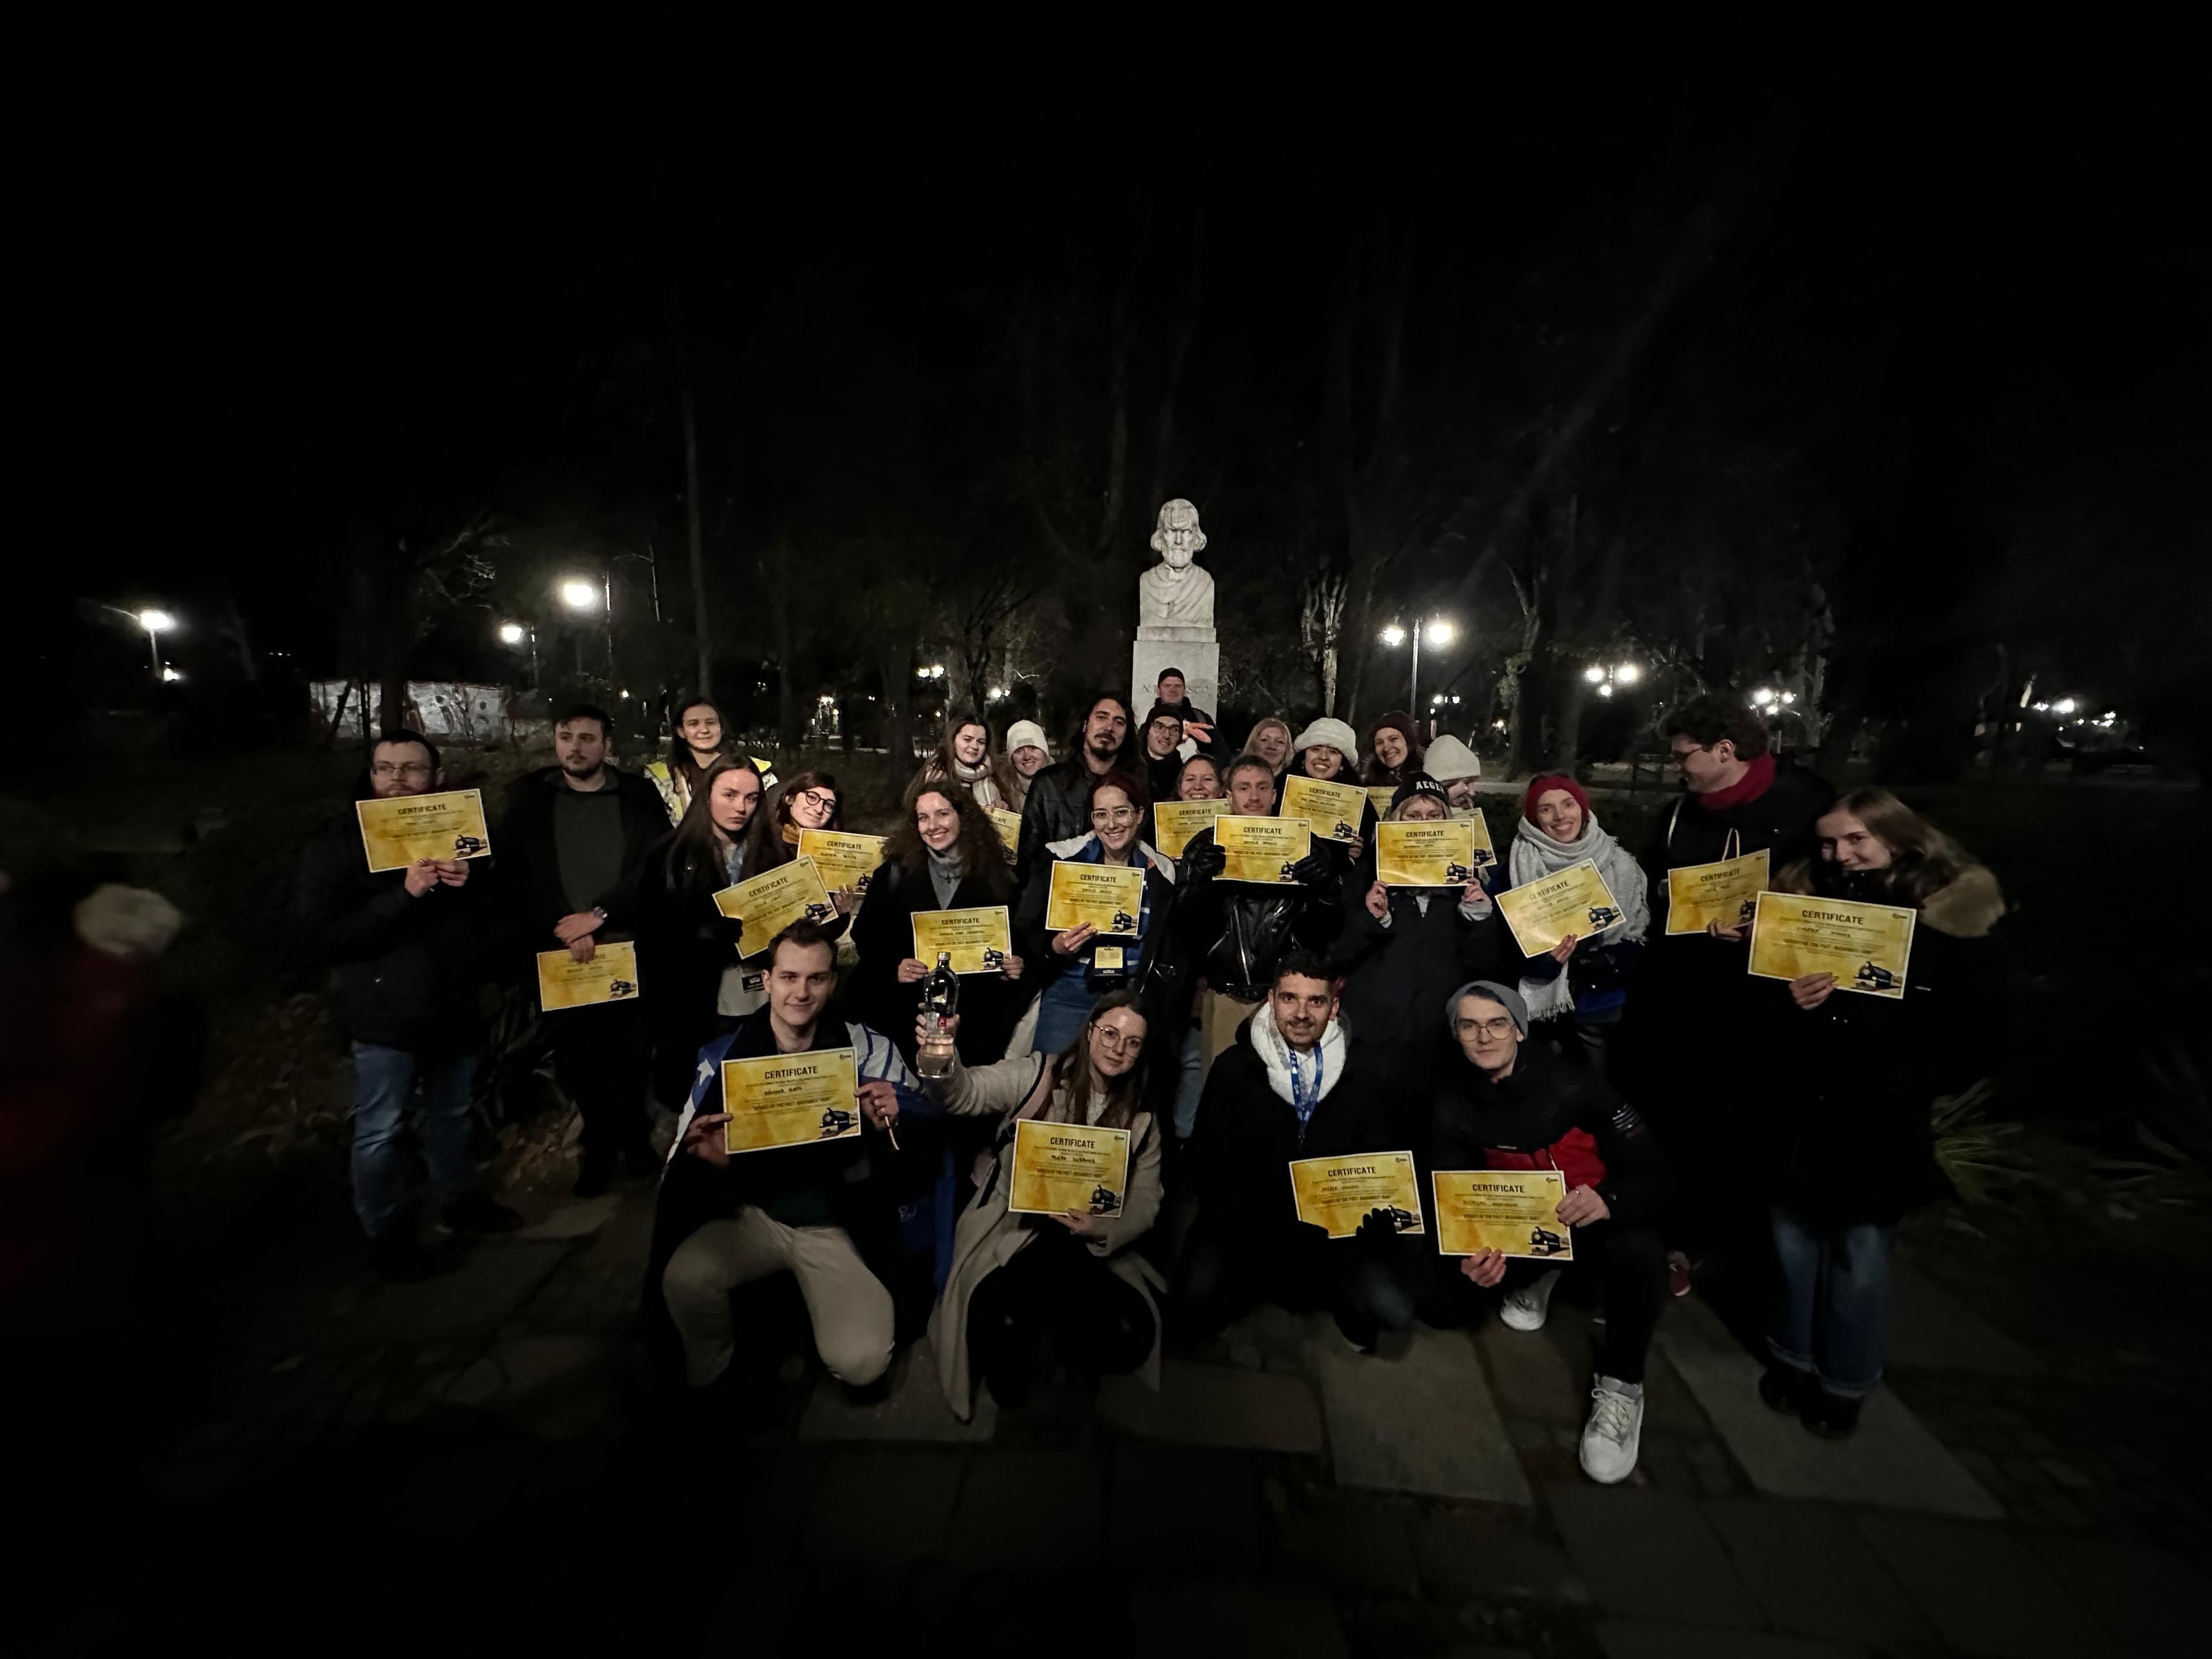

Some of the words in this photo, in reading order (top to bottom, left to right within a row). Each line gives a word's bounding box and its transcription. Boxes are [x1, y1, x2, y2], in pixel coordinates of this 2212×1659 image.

[1309, 787, 1341, 798] CERTIFICATE
[397, 804, 447, 815] CERTIFICATE
[827, 840, 862, 850] CERTIFICATE
[1080, 874, 1116, 883] CERTIFICATE
[1700, 869, 1740, 882] CERTIFICATE
[749, 876, 789, 897] CERTIFICATE
[1529, 881, 1569, 899] CERTIFICATE
[941, 917, 980, 925] CERTIFICATE
[1802, 910, 1863, 925] CERTIFICATE
[764, 1066, 818, 1080] CERTIFICATE
[1050, 1137, 1096, 1148] CERTIFICATE
[1328, 1166, 1376, 1177] CERTIFICATE
[1472, 1184, 1525, 1192] CERTIFICATE
